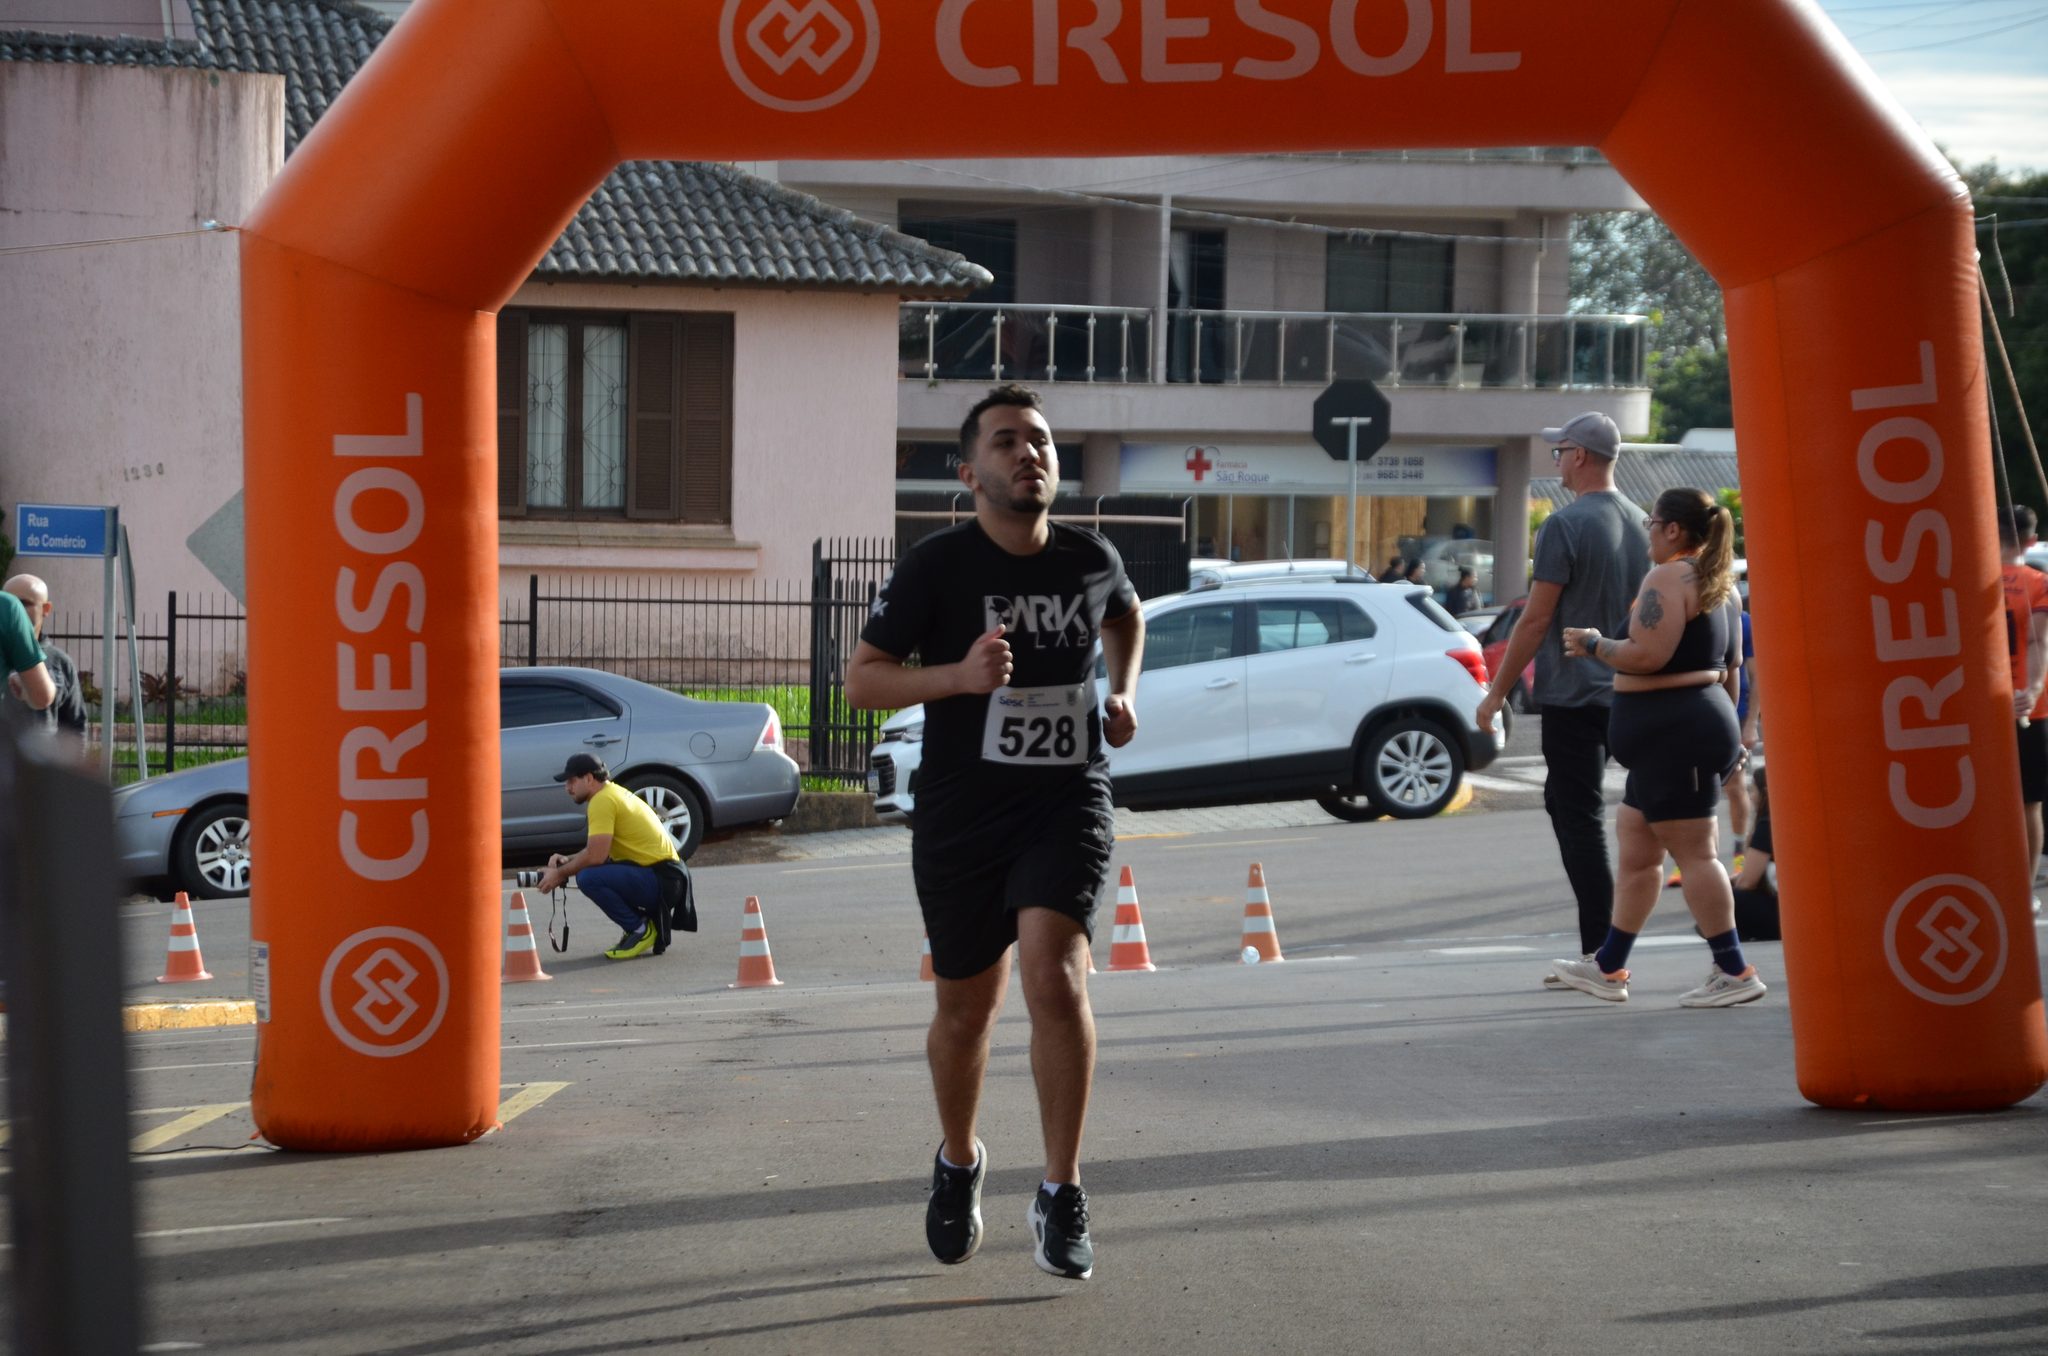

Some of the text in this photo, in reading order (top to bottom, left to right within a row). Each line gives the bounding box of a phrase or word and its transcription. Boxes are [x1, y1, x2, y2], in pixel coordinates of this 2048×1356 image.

[935, 0, 1522, 87] CRESOL
[1238, 471, 1270, 484] Roque
[28, 513, 49, 528] Rua
[27, 533, 87, 549] do Comércio
[1851, 340, 1975, 829] CRESOL
[333, 392, 428, 881] CRESOL
[1034, 630, 1090, 649] LAB
[998, 715, 1077, 758] 528
